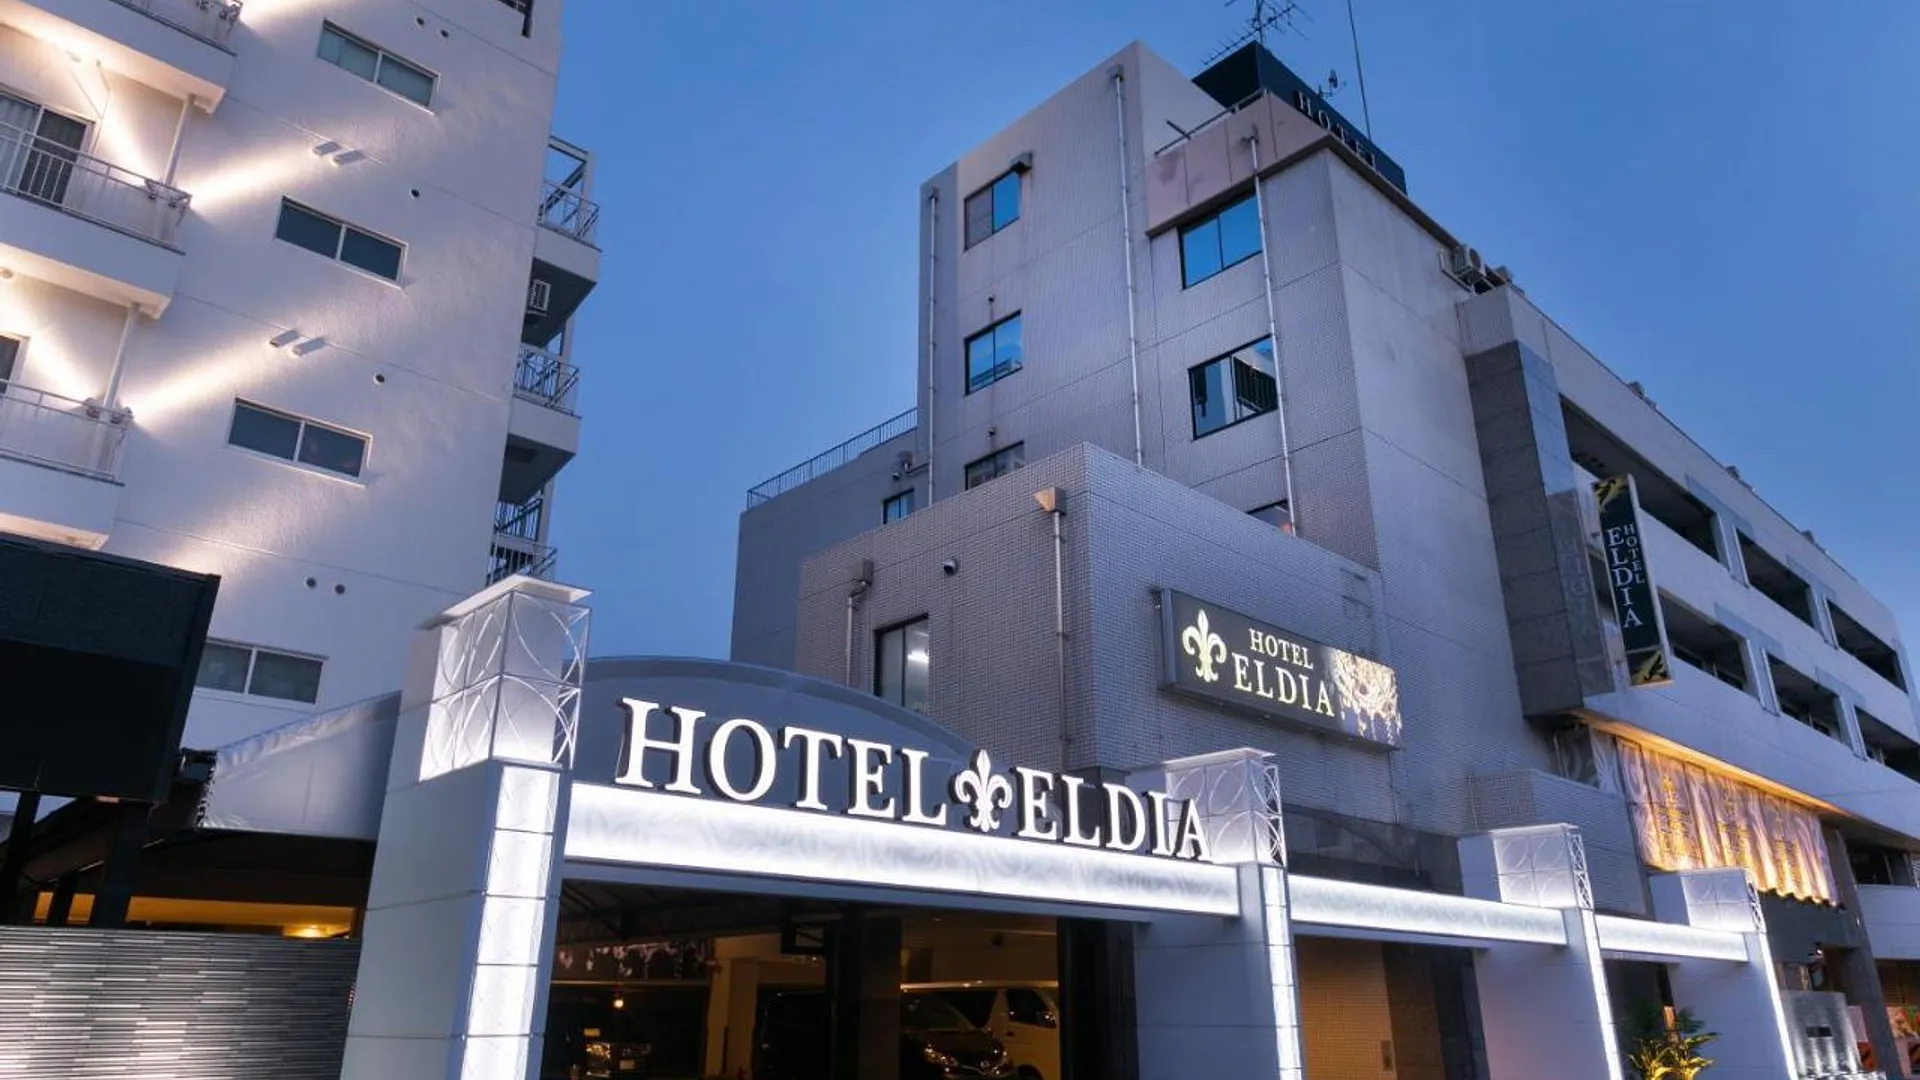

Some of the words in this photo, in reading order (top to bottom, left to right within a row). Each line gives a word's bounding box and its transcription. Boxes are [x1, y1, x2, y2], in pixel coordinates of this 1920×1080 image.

[1607, 527, 1644, 628] ELDIA
[1624, 523, 1645, 584] HOTEL
[1249, 628, 1314, 670] HOTEL
[1232, 653, 1335, 717] ELDIA
[614, 697, 947, 826] HOTEL
[1014, 766, 1212, 862] ELDIA
